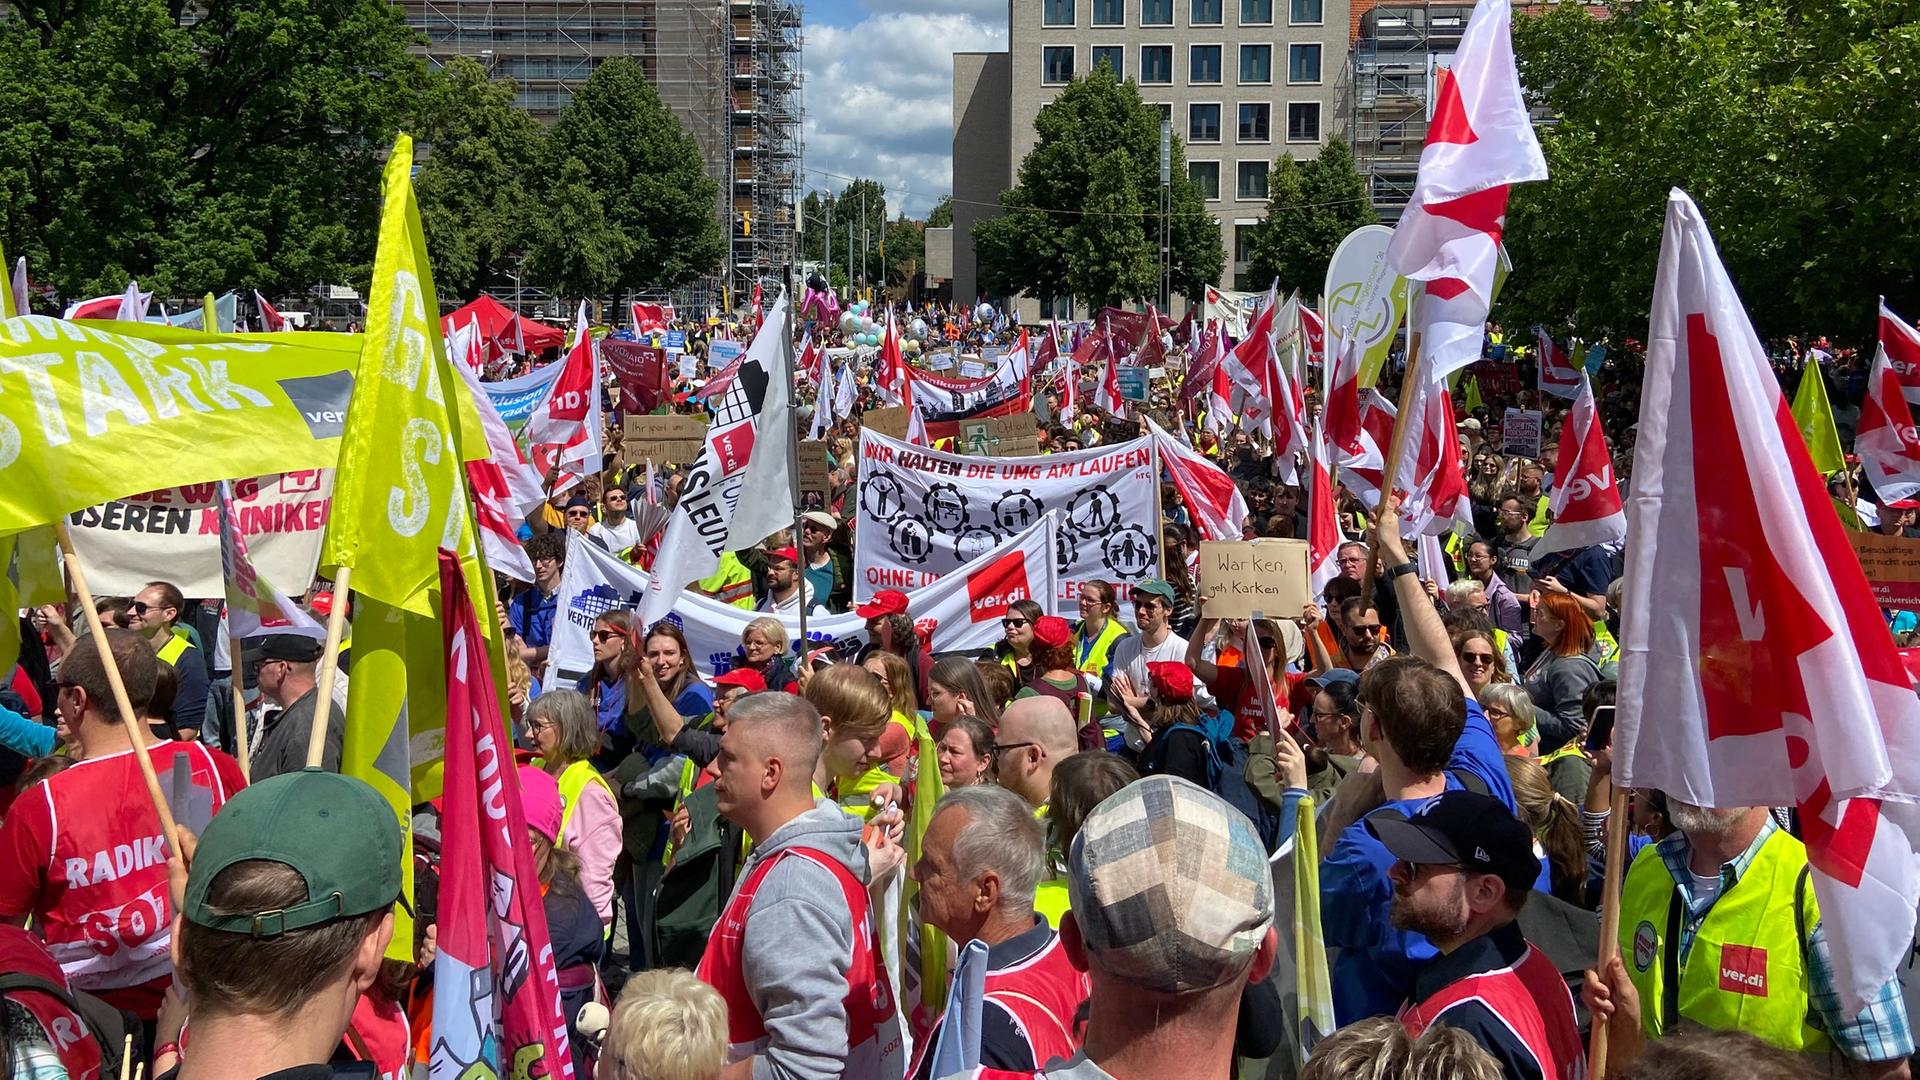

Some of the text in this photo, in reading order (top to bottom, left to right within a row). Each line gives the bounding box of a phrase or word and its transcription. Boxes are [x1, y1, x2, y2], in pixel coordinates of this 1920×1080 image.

[864, 441, 1150, 480] WIR HALTEN DIE UMG AM LAUFEN
[866, 567, 915, 588] OHNE
[1207, 580, 1279, 598] geh Karken
[973, 586, 1025, 610] ver.di
[567, 609, 596, 632] VERTR
[65, 834, 168, 890] RADIK
[1721, 967, 1764, 988] ver.di
